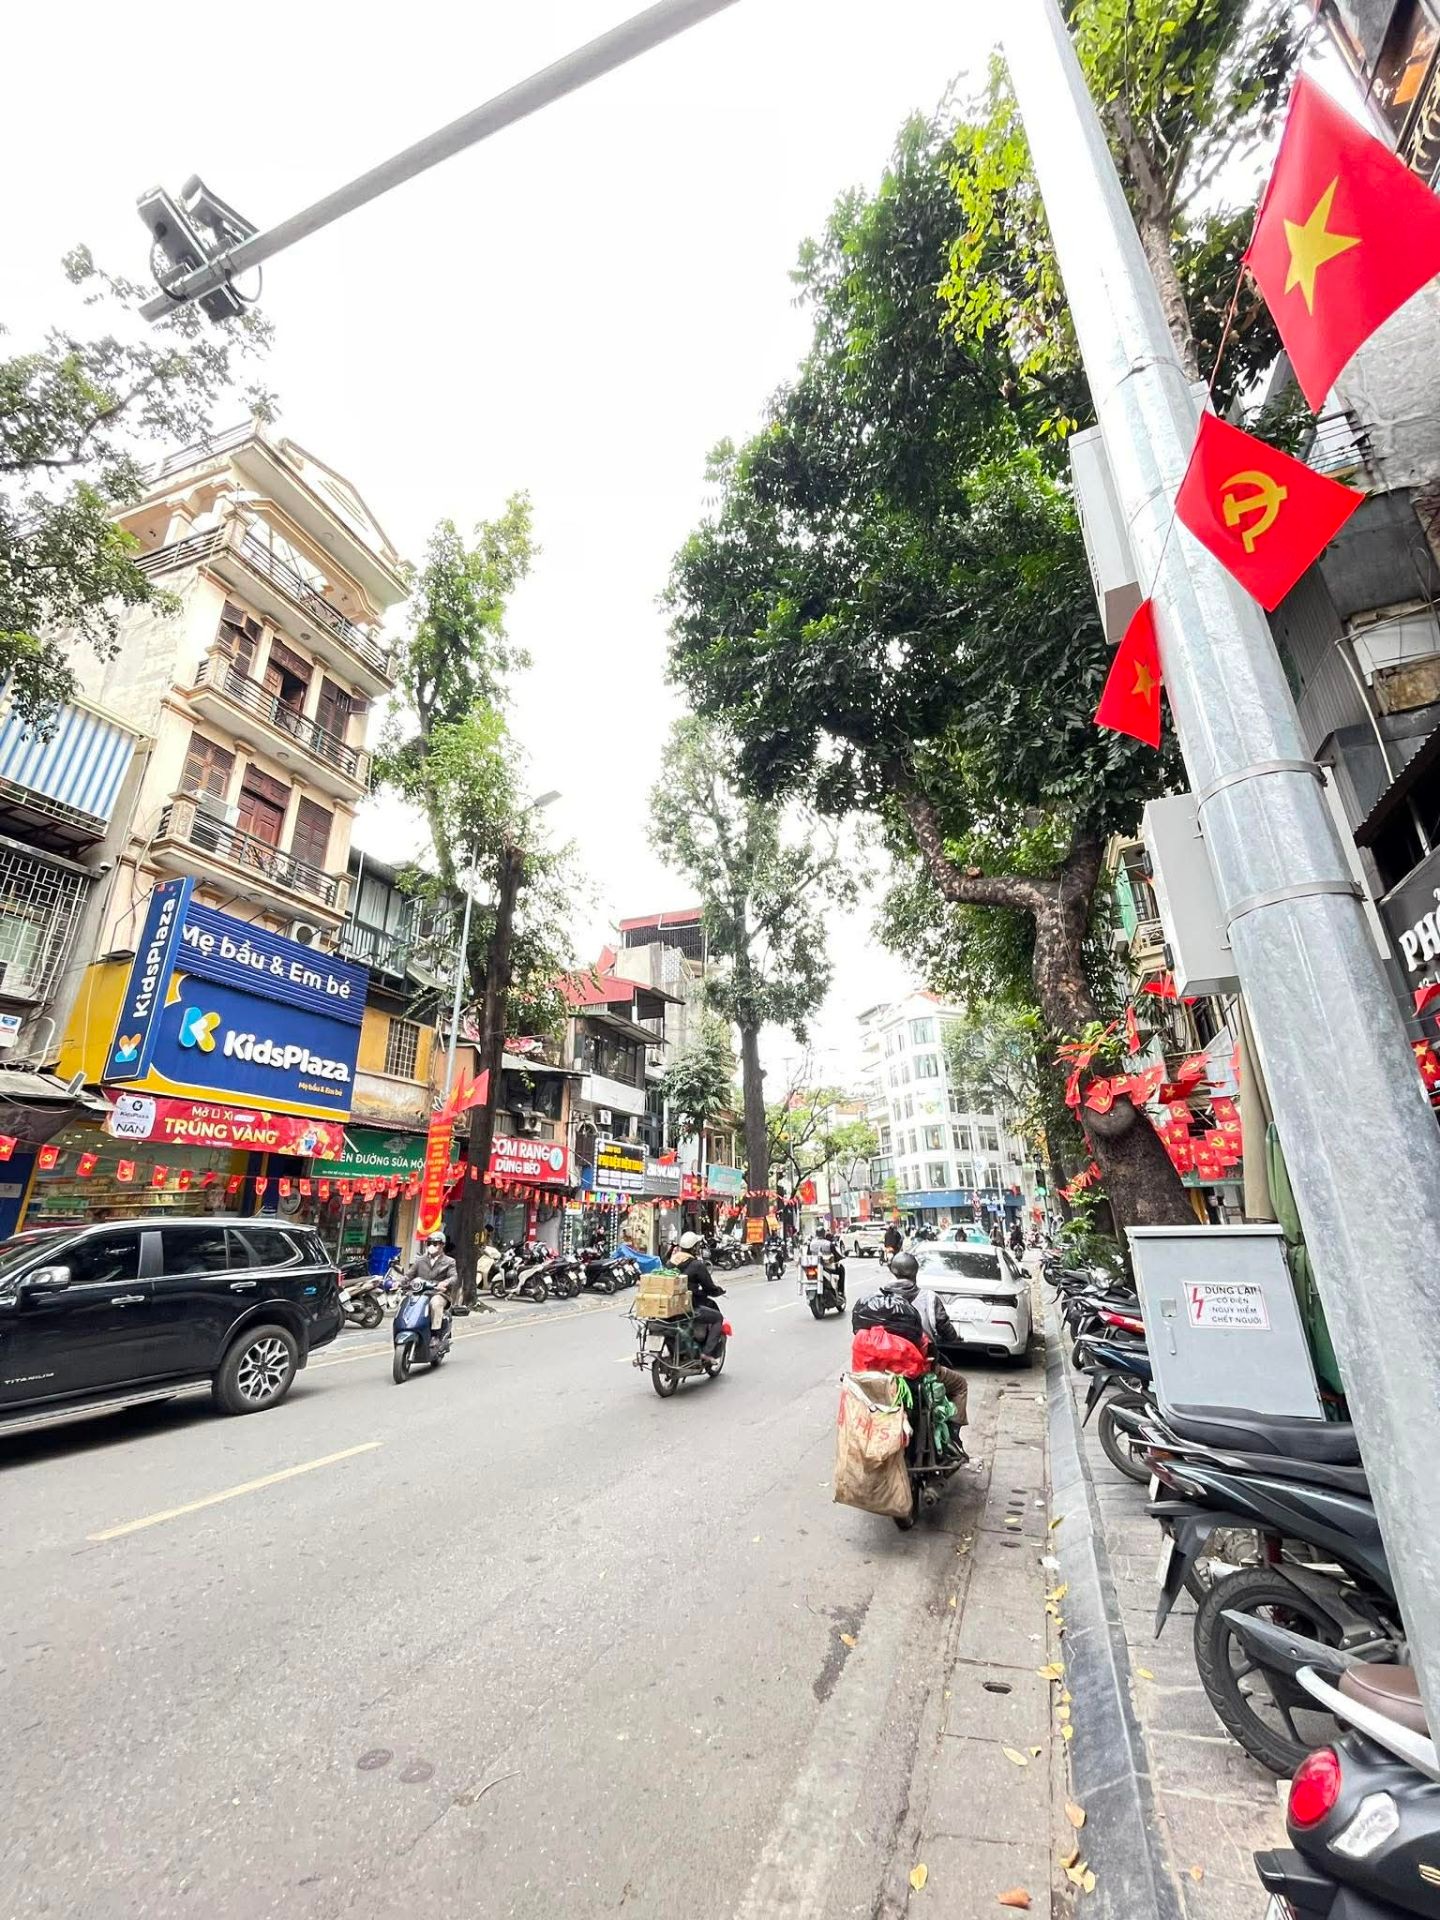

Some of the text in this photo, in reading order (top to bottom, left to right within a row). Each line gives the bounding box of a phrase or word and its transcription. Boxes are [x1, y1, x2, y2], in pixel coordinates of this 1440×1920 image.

[1399, 888, 1440, 972] PH
[133, 898, 175, 1018] KidsPlaza
[182, 923, 351, 999] Mẹ bầu & Em bé
[223, 1030, 349, 1082] KidsPlaza
[116, 1122, 146, 1135] NAN
[164, 1116, 228, 1139] TRÚNG
[231, 1124, 278, 1145] VÀNG
[355, 1152, 389, 1166] ĐƯỜNG
[495, 1156, 523, 1173] DŨNG
[519, 1142, 551, 1161] RANG
